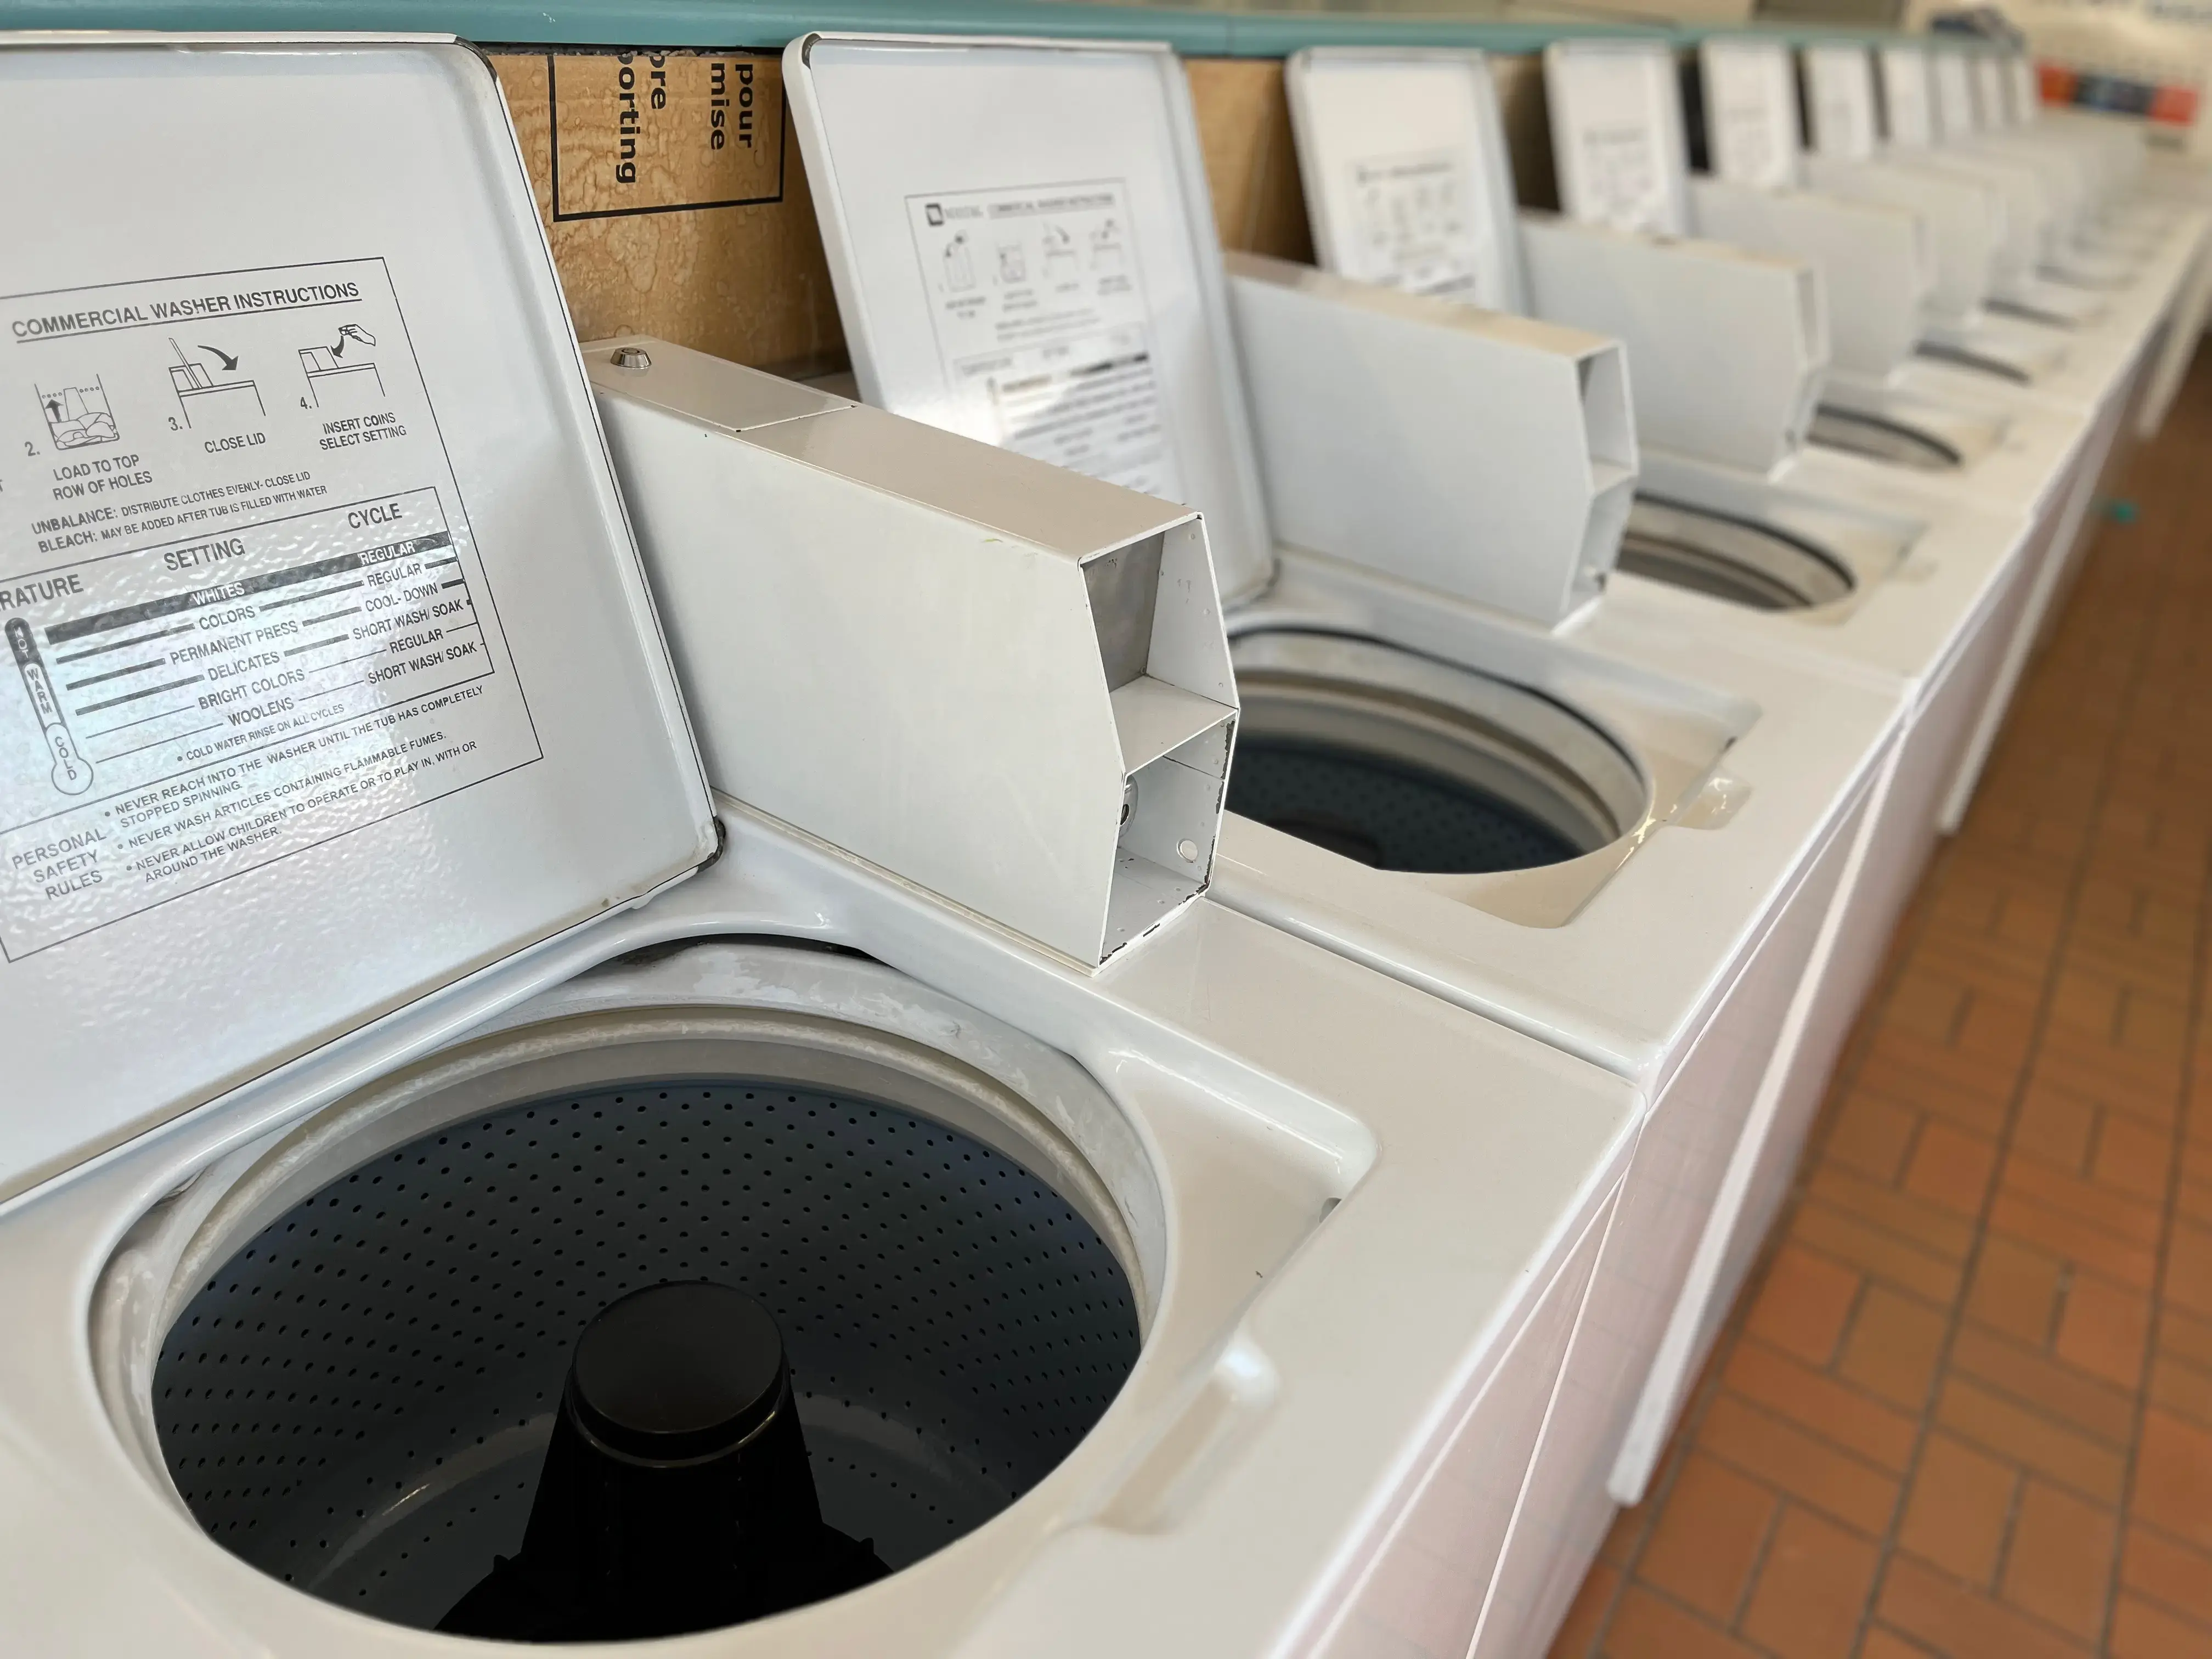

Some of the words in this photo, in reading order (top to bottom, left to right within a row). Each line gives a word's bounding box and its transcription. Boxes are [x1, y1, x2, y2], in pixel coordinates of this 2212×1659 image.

[711, 63, 729, 150] mise
[736, 64, 753, 148] pour
[12, 305, 148, 337] COMMERCIAL
[150, 296, 231, 319] WASHER
[233, 283, 359, 309] INSTRUCTIONS
[300, 397, 312, 409] 4.
[168, 417, 183, 431] 3.
[319, 433, 360, 450] SELECT
[363, 425, 407, 442] SETTING
[323, 418, 360, 434] INSERT
[363, 412, 396, 427] COINS
[24, 441, 40, 456] 2.
[205, 436, 245, 453] CLOSE
[248, 432, 266, 445] LID
[53, 463, 91, 481] LOAD
[92, 459, 111, 473] TO
[112, 454, 139, 468] TOP
[53, 484, 84, 500] ROW
[88, 479, 105, 494] OF
[108, 471, 153, 489] HOLES
[31, 507, 119, 535] UNBALANCE:
[121, 496, 179, 516] DISTRIBUTE
[181, 488, 225, 505] CLOTHES
[265, 475, 295, 488] CLOSE
[296, 471, 311, 482] LID
[348, 503, 403, 529] CYCLE
[38, 531, 98, 553] BLEACH:
[101, 527, 122, 539] MAY
[126, 523, 139, 535] BE
[142, 516, 174, 532] ADDED
[178, 507, 208, 524] AFTER
[208, 505, 228, 517] TUB
[230, 503, 240, 512] IS
[241, 497, 272, 510] FILLED
[273, 492, 296, 504] WITH
[297, 486, 328, 500] WATER
[164, 538, 245, 571] SETTING
[359, 541, 415, 565] REGULAR
[367, 563, 422, 586] REGULAR
[192, 582, 245, 605] WHITES
[404, 583, 438, 602] DOWN
[199, 606, 256, 630] COLORS
[353, 619, 392, 640] SHORT
[433, 599, 464, 618] SOAK
[170, 632, 252, 664] PERMANENT
[255, 620, 298, 642] PRESS
[390, 628, 443, 653] REGULAR
[207, 651, 280, 680] DELICATES
[368, 663, 407, 684] SHORT
[447, 641, 477, 660] SOAK
[27, 668, 53, 714] WARM
[198, 685, 247, 709] BRIGHT
[251, 669, 305, 693] COLORS
[228, 697, 295, 726] WOOLENS
[187, 744, 213, 760] COLD
[214, 734, 247, 752] WATER
[249, 727, 275, 740] RINSE
[277, 720, 291, 731] ON
[293, 715, 310, 727] ALL
[311, 704, 344, 721] CYCLES
[55, 736, 77, 781] COLD
[115, 793, 159, 815] NEVER
[162, 778, 205, 799] REACH
[208, 768, 236, 784] INTO
[238, 759, 263, 773] THE
[267, 741, 317, 763] WASHER
[318, 731, 350, 747] UNTIL
[351, 723, 373, 736] THE
[374, 715, 396, 729] TUB
[398, 707, 419, 721] HAS
[421, 686, 483, 713] COMPLETELY
[128, 826, 172, 848] NEVER
[174, 812, 211, 832] WASH
[215, 792, 271, 819] ARTICLES
[274, 767, 342, 797] CONTAINING
[344, 744, 408, 773] FLAMMABLE
[409, 731, 447, 750] FUMES.
[121, 801, 179, 828] STOPPED
[136, 848, 180, 871] NEVER
[183, 831, 225, 853] ALLOW
[228, 809, 287, 837] CHILDREN
[290, 803, 305, 814] TO
[308, 784, 357, 808] OPERATE
[360, 777, 376, 789] OR
[377, 772, 392, 782] TO
[394, 761, 419, 777] PLAY
[421, 757, 435, 768] IN,
[435, 747, 460, 762] WITH
[462, 741, 477, 753] OR
[12, 829, 106, 870] PERSONAL
[145, 856, 198, 883] AROUND
[200, 846, 225, 861] THE
[227, 827, 282, 851] WASHER.
[33, 850, 99, 883] SAFETY
[45, 870, 103, 900] RULES
